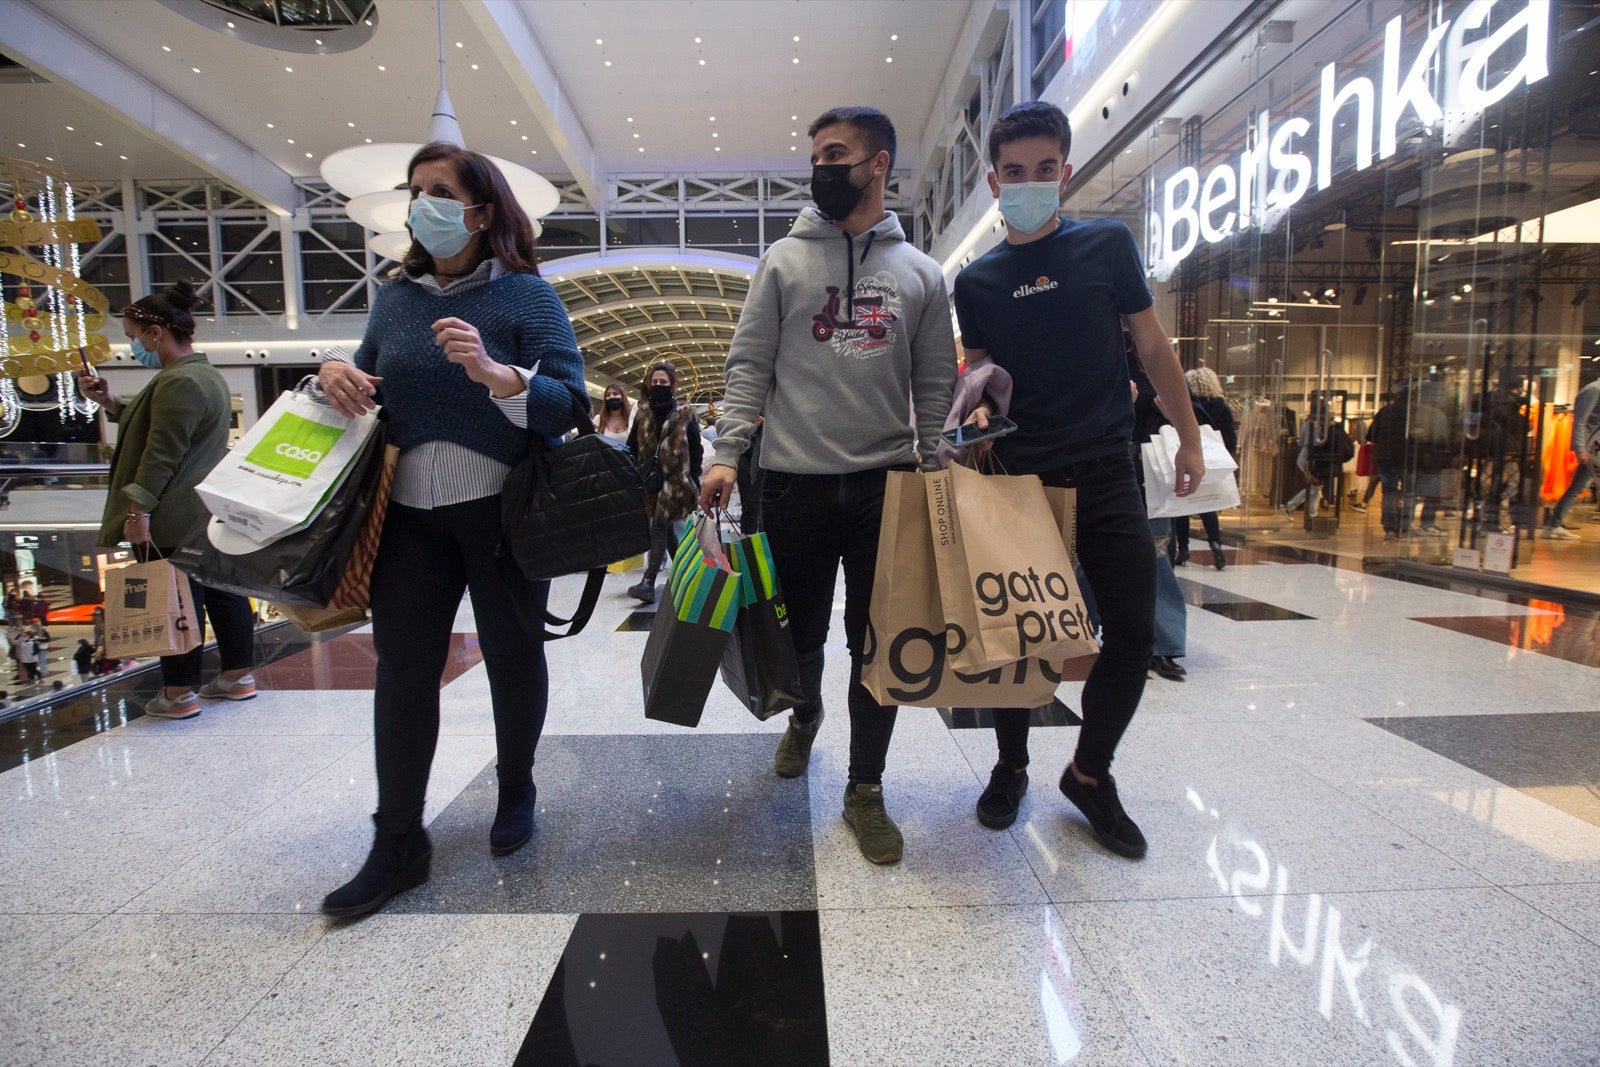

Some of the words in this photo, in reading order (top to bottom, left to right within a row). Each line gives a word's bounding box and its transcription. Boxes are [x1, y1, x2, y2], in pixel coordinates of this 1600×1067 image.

[1163, 0, 1551, 265] Bershka
[1013, 280, 1059, 298] ellesse
[275, 442, 323, 463] casa
[933, 478, 946, 516] ONLINE
[939, 518, 949, 546] SHOP
[125, 583, 148, 594] fnac
[975, 566, 1069, 616] gato
